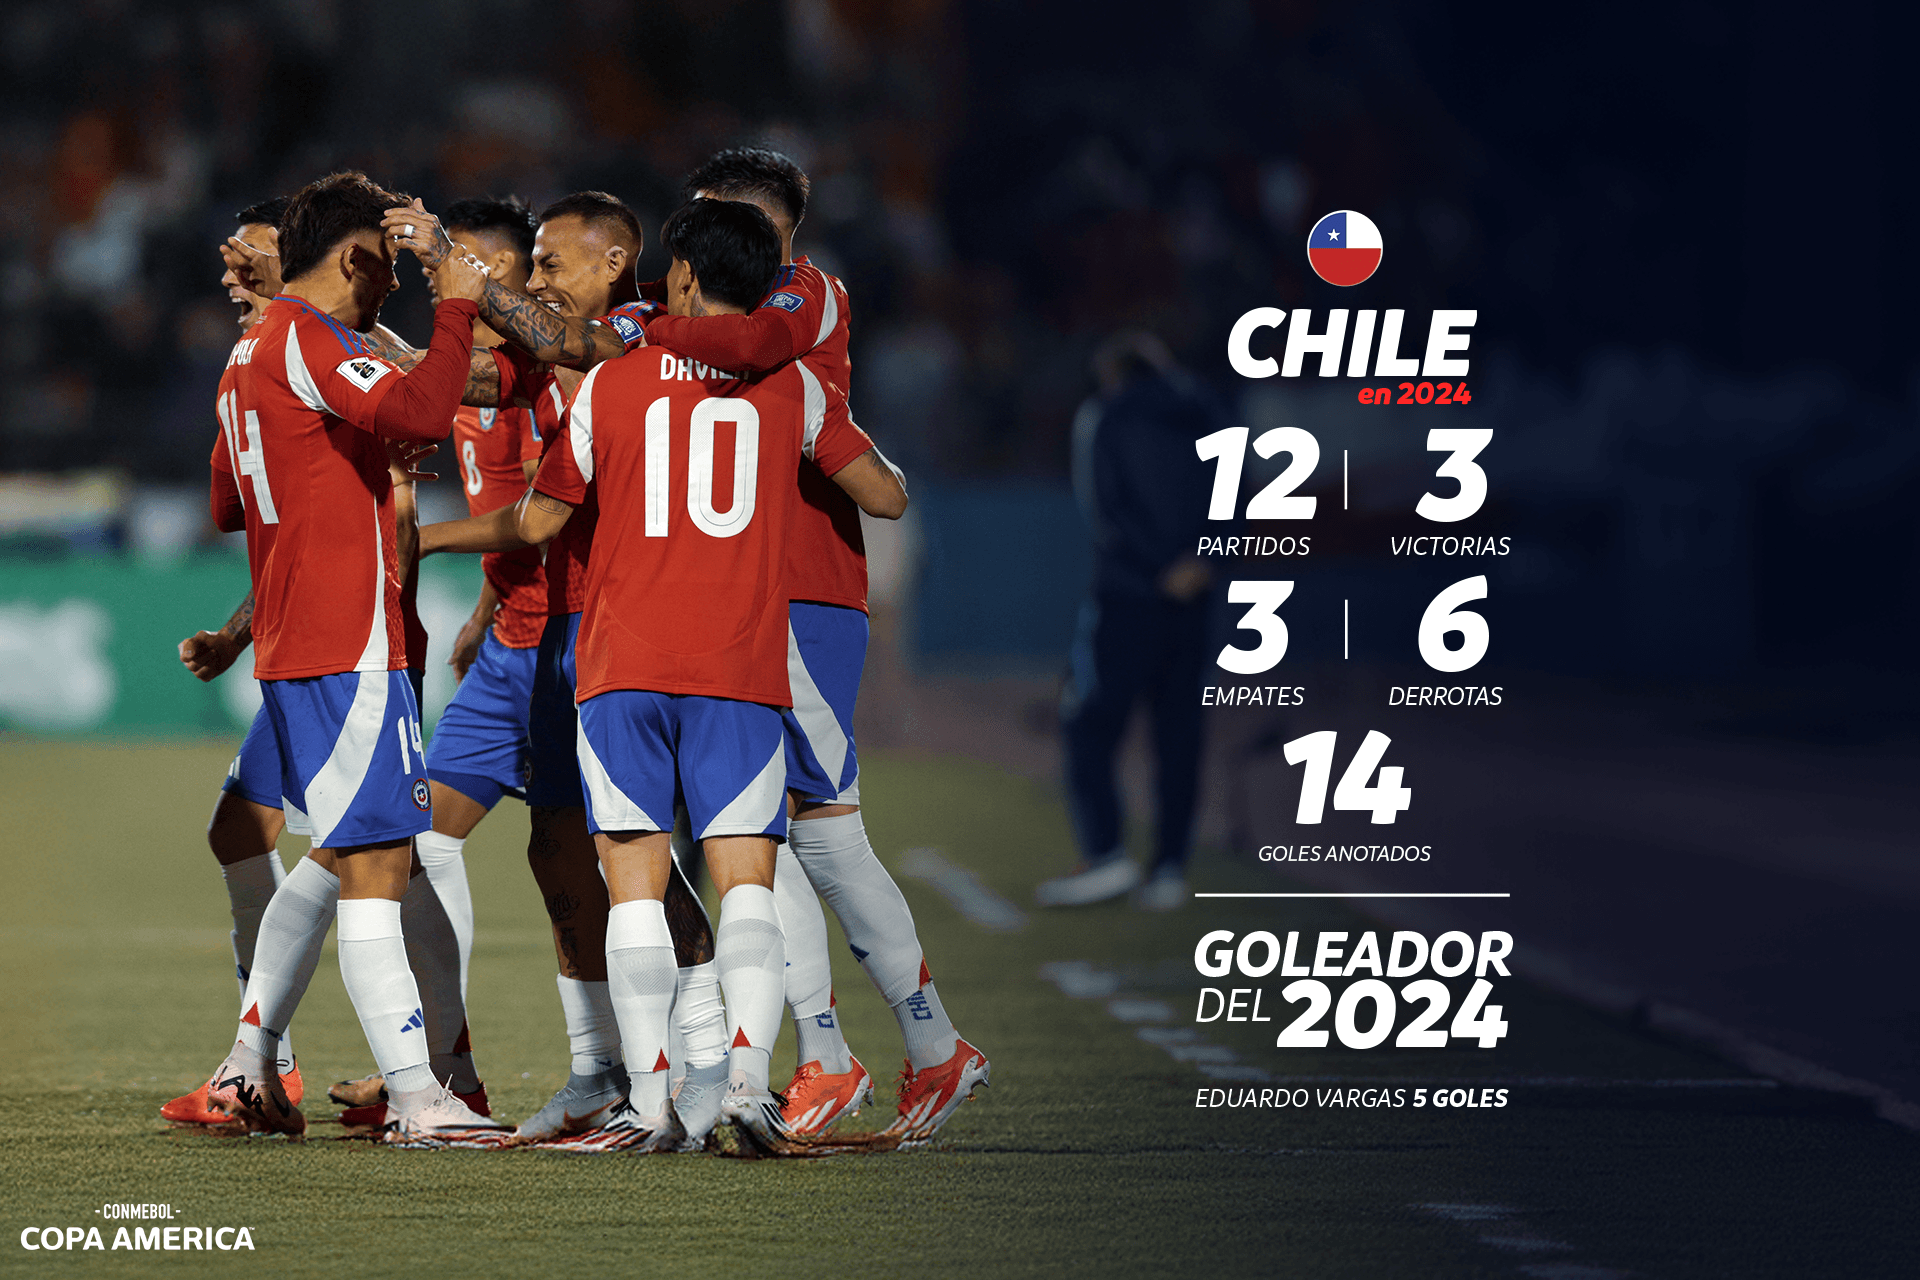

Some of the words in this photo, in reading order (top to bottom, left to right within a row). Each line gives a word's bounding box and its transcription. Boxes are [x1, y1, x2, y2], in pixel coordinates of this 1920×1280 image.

[660, 353, 750, 381] DAV
[218, 389, 279, 524] 14
[463, 441, 483, 496] 8
[645, 396, 760, 538] 10
[398, 714, 427, 774] 14
